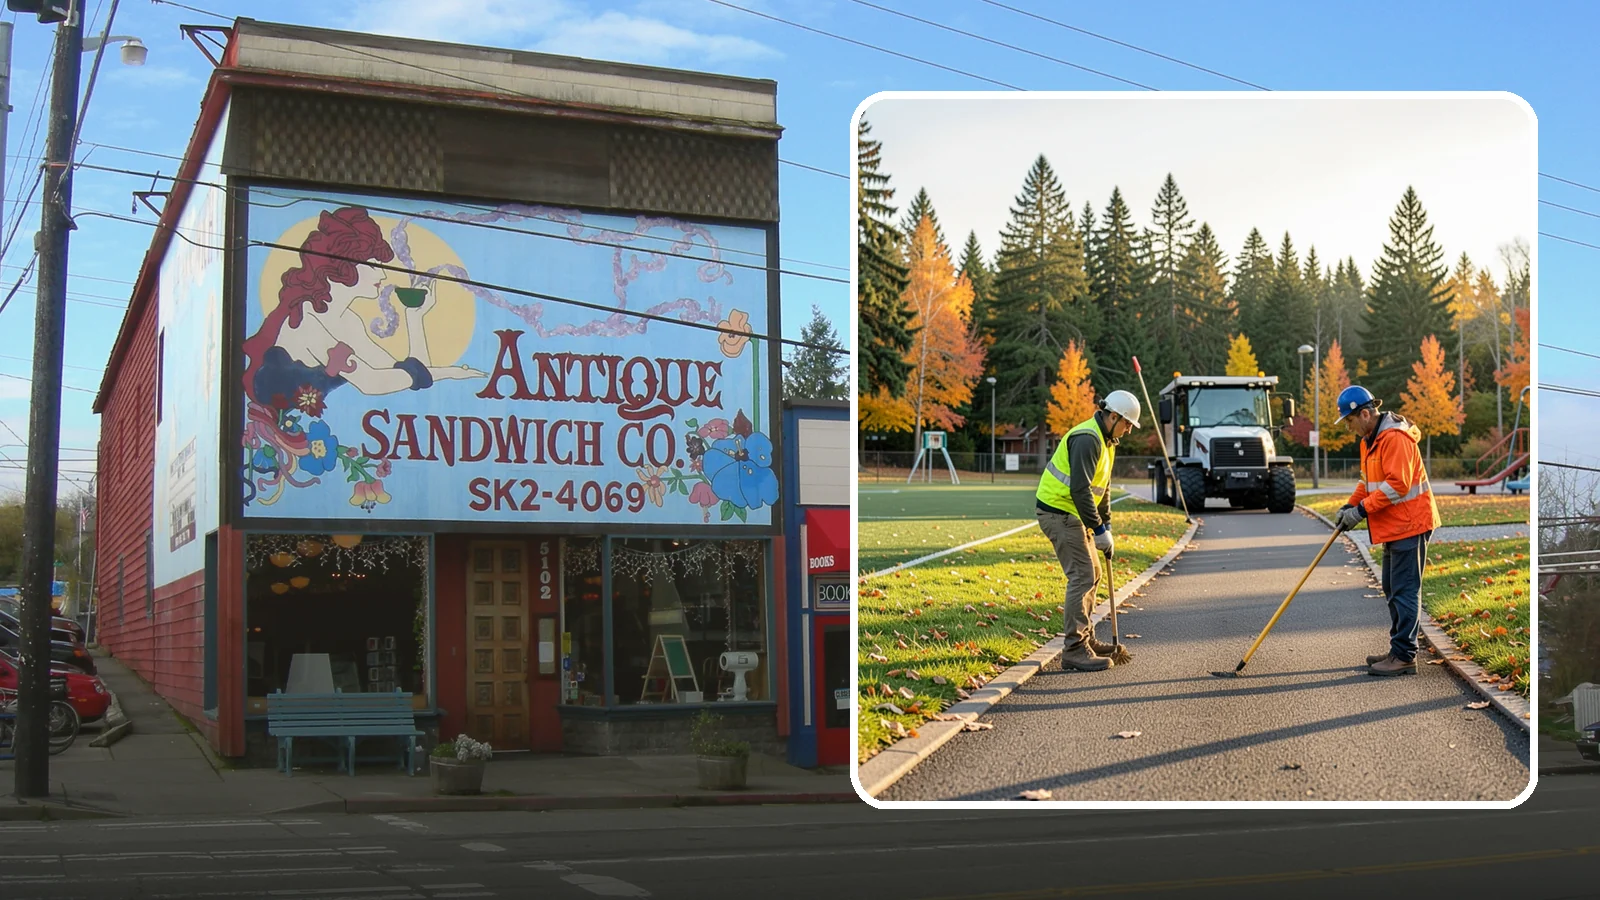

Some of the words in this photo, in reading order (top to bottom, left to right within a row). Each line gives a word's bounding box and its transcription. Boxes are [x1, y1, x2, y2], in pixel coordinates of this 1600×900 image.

[476, 329, 722, 421] ANTIQUE
[362, 409, 604, 467] SANDWICH
[617, 421, 685, 469] CO.
[469, 477, 645, 512] SK2-4069
[539, 541, 551, 600] 5102
[809, 555, 835, 569] BOOKS
